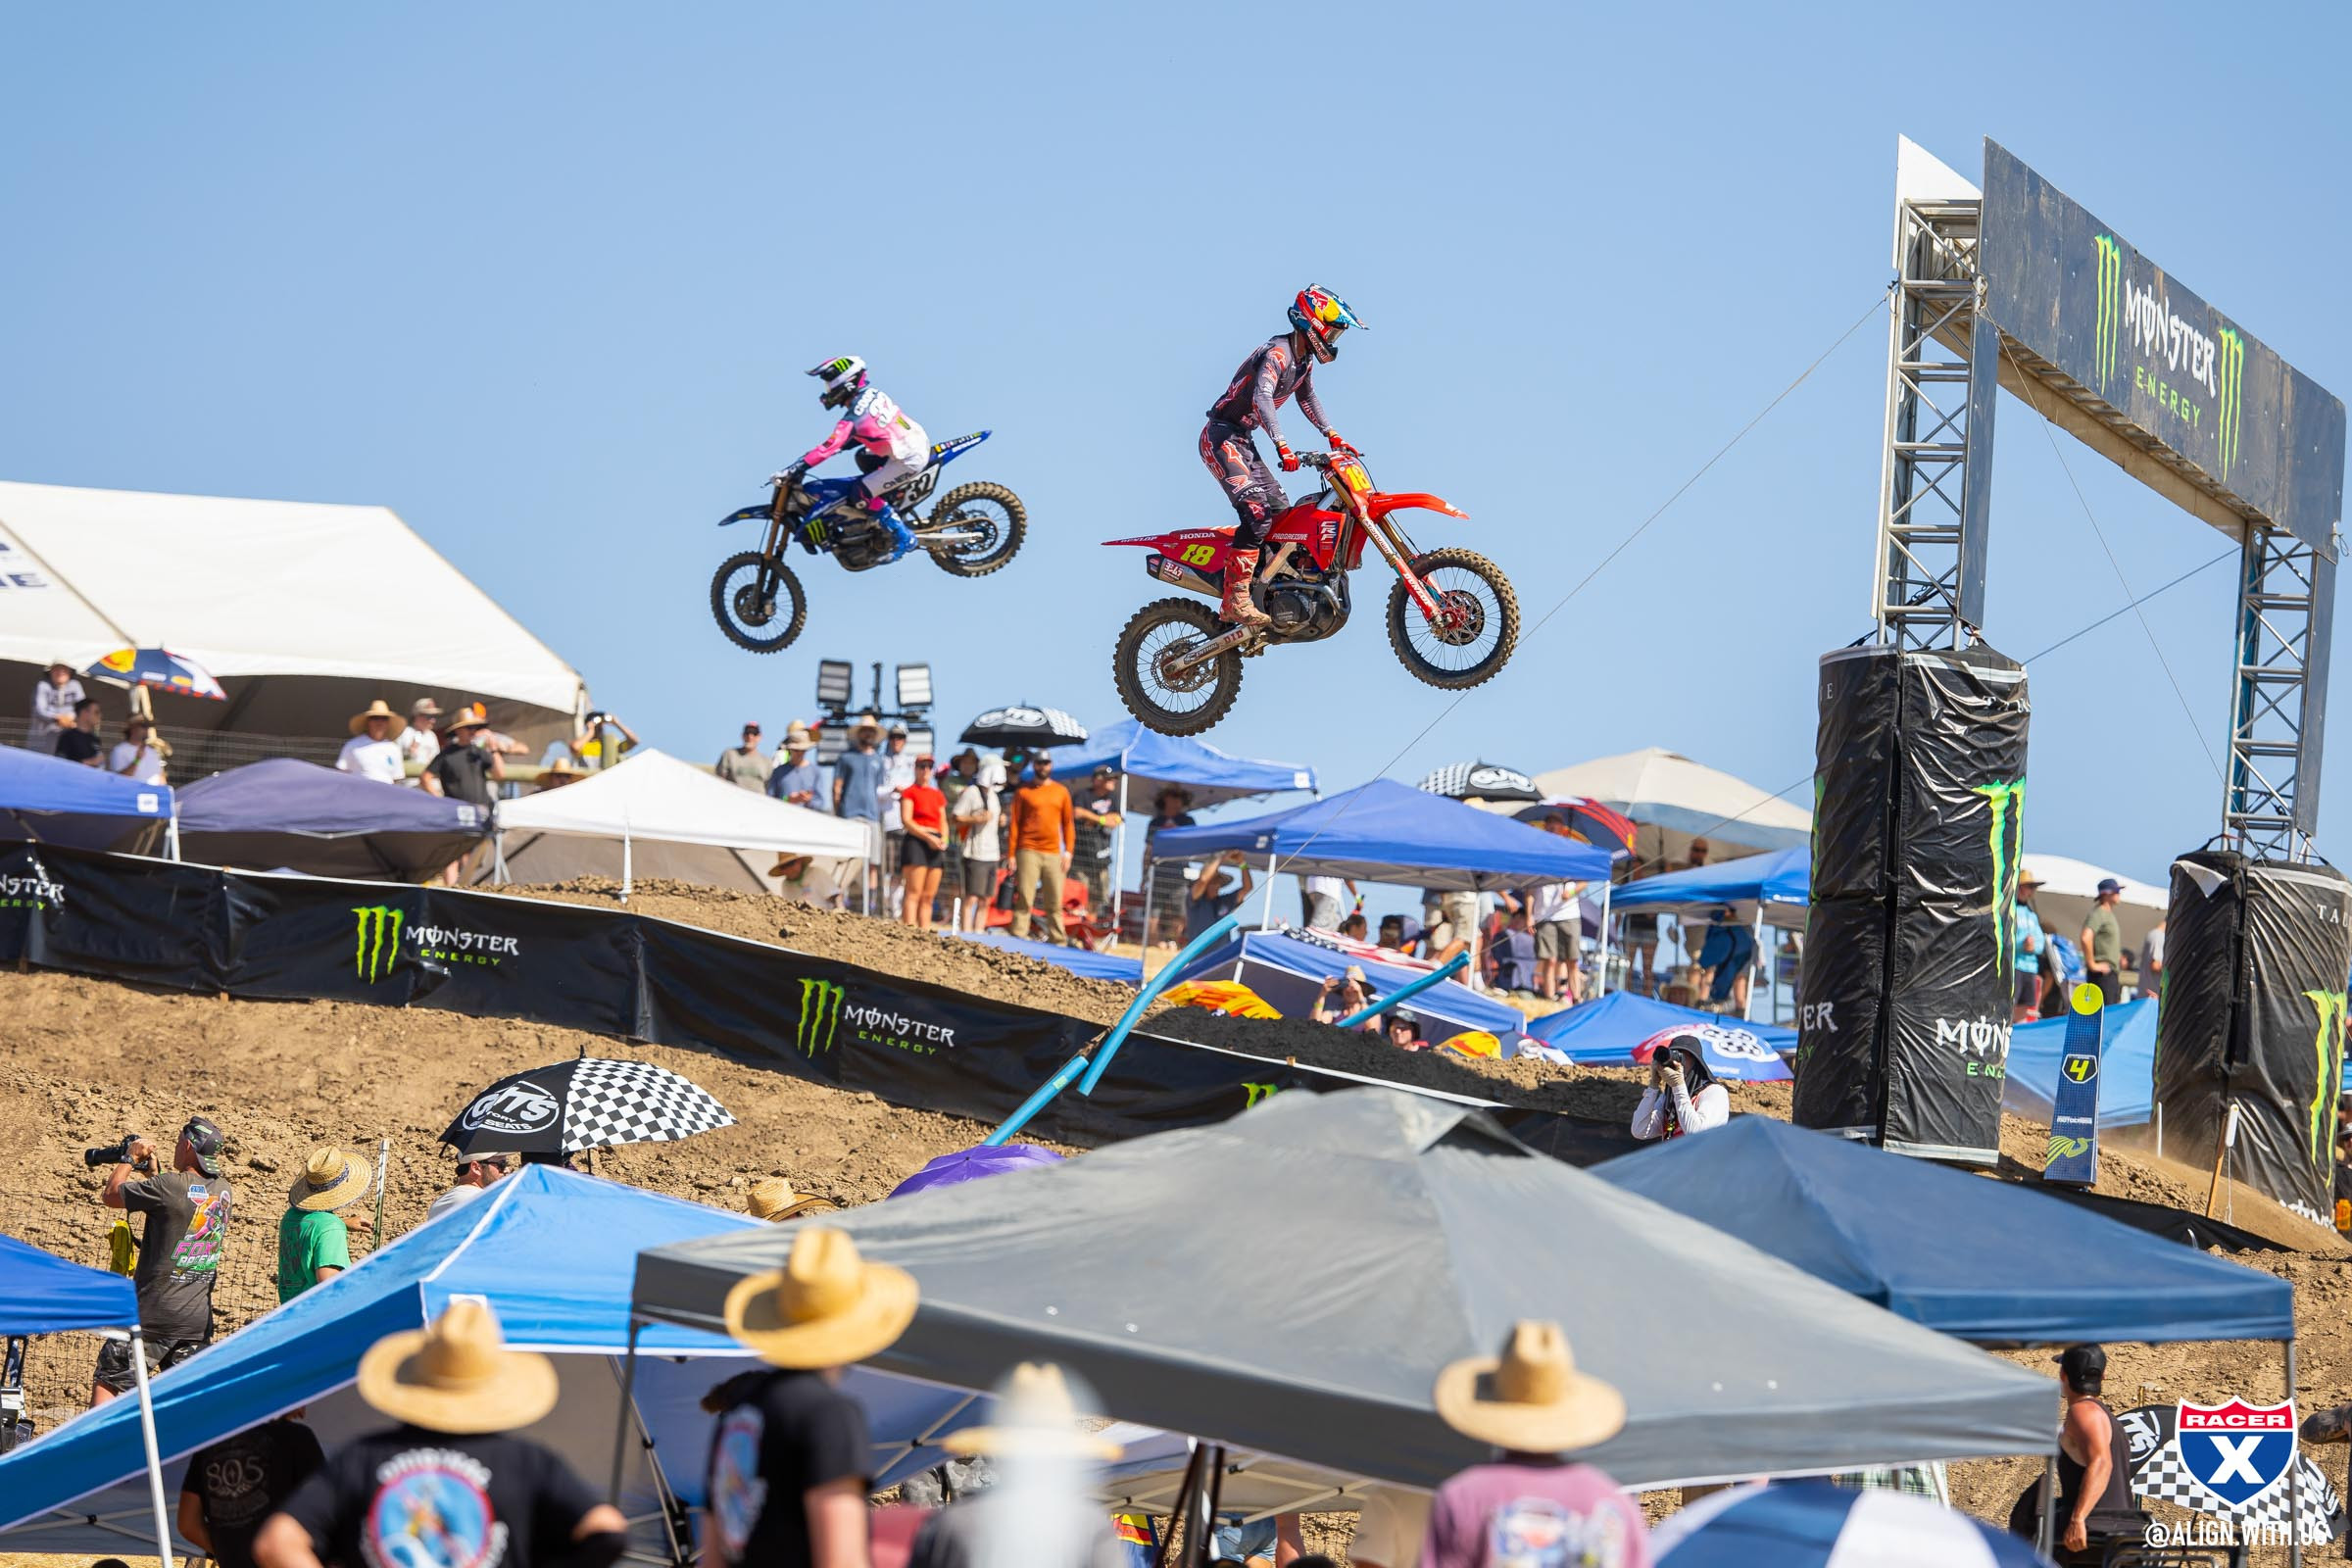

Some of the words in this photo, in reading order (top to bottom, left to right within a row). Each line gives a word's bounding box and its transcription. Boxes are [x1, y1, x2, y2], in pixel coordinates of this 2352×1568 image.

[2136, 366, 2201, 427] ENERGY
[908, 473, 931, 501] 32
[1346, 465, 1371, 491] 18
[1180, 544, 1215, 565] 18
[1403, 573, 1433, 608] DUNLOP
[420, 949, 501, 966] ENERGY
[858, 1031, 936, 1055] ENERGY
[2069, 1059, 2089, 1081] 4
[484, 1118, 533, 1130] SEATS
[172, 1241, 218, 1258] FOX
[206, 1456, 265, 1491] 805
